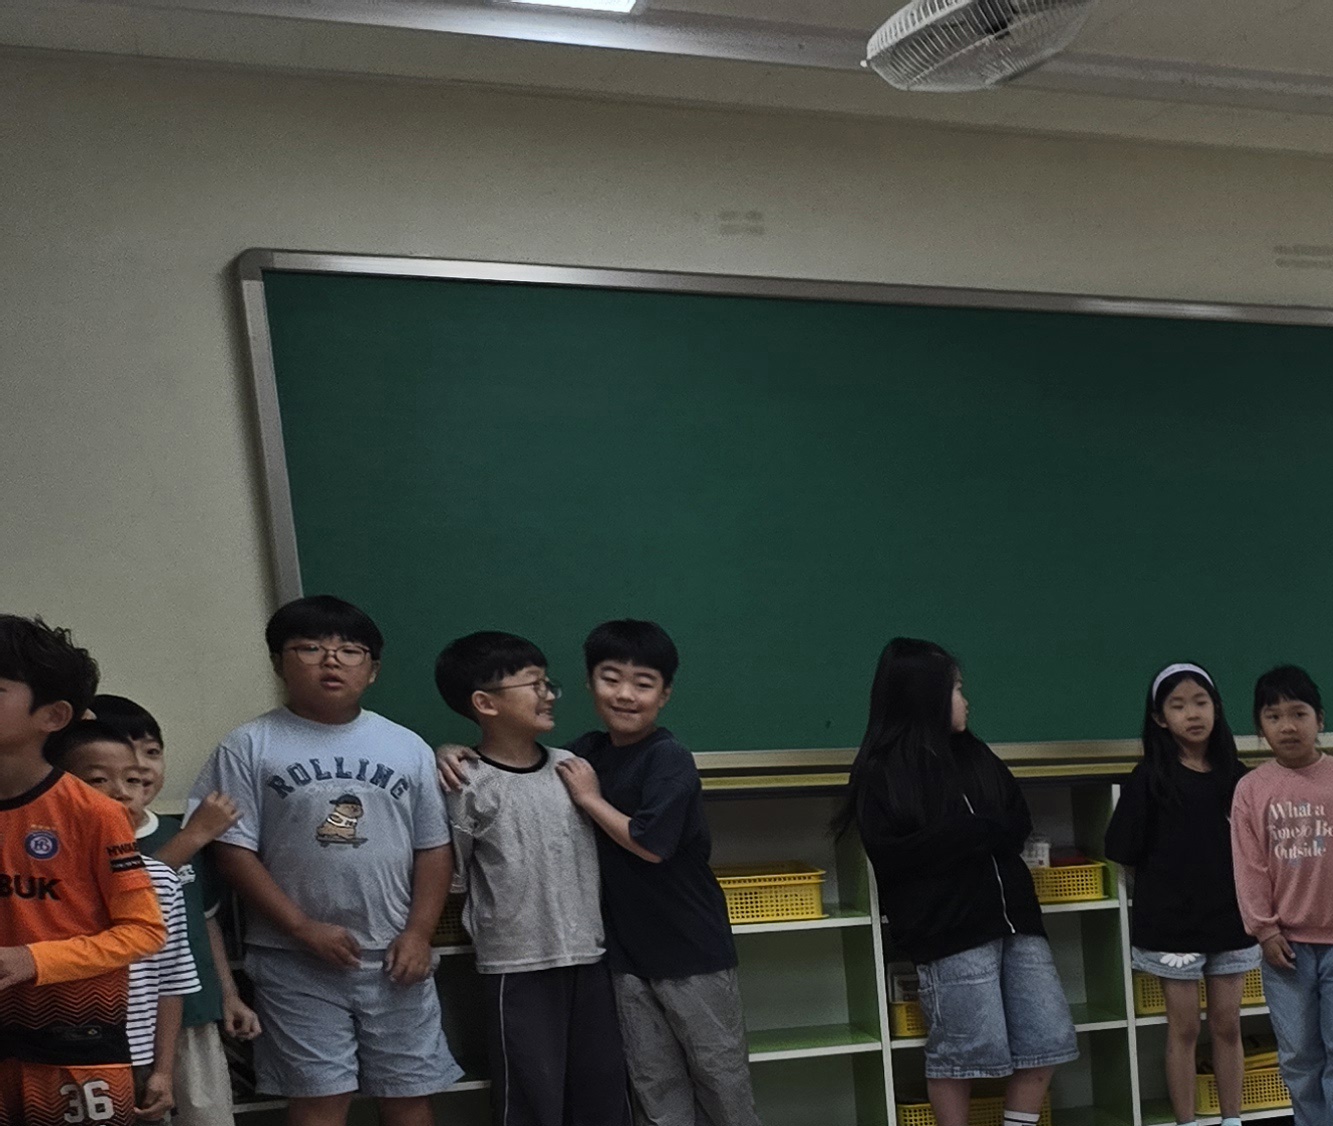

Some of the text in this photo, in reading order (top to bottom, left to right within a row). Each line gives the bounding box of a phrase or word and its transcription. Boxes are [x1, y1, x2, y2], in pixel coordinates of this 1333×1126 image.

[267, 756, 410, 800] ROLLING
[1269, 801, 1312, 819] What
[0, 873, 62, 901] BUK
[59, 1079, 116, 1124] 36
